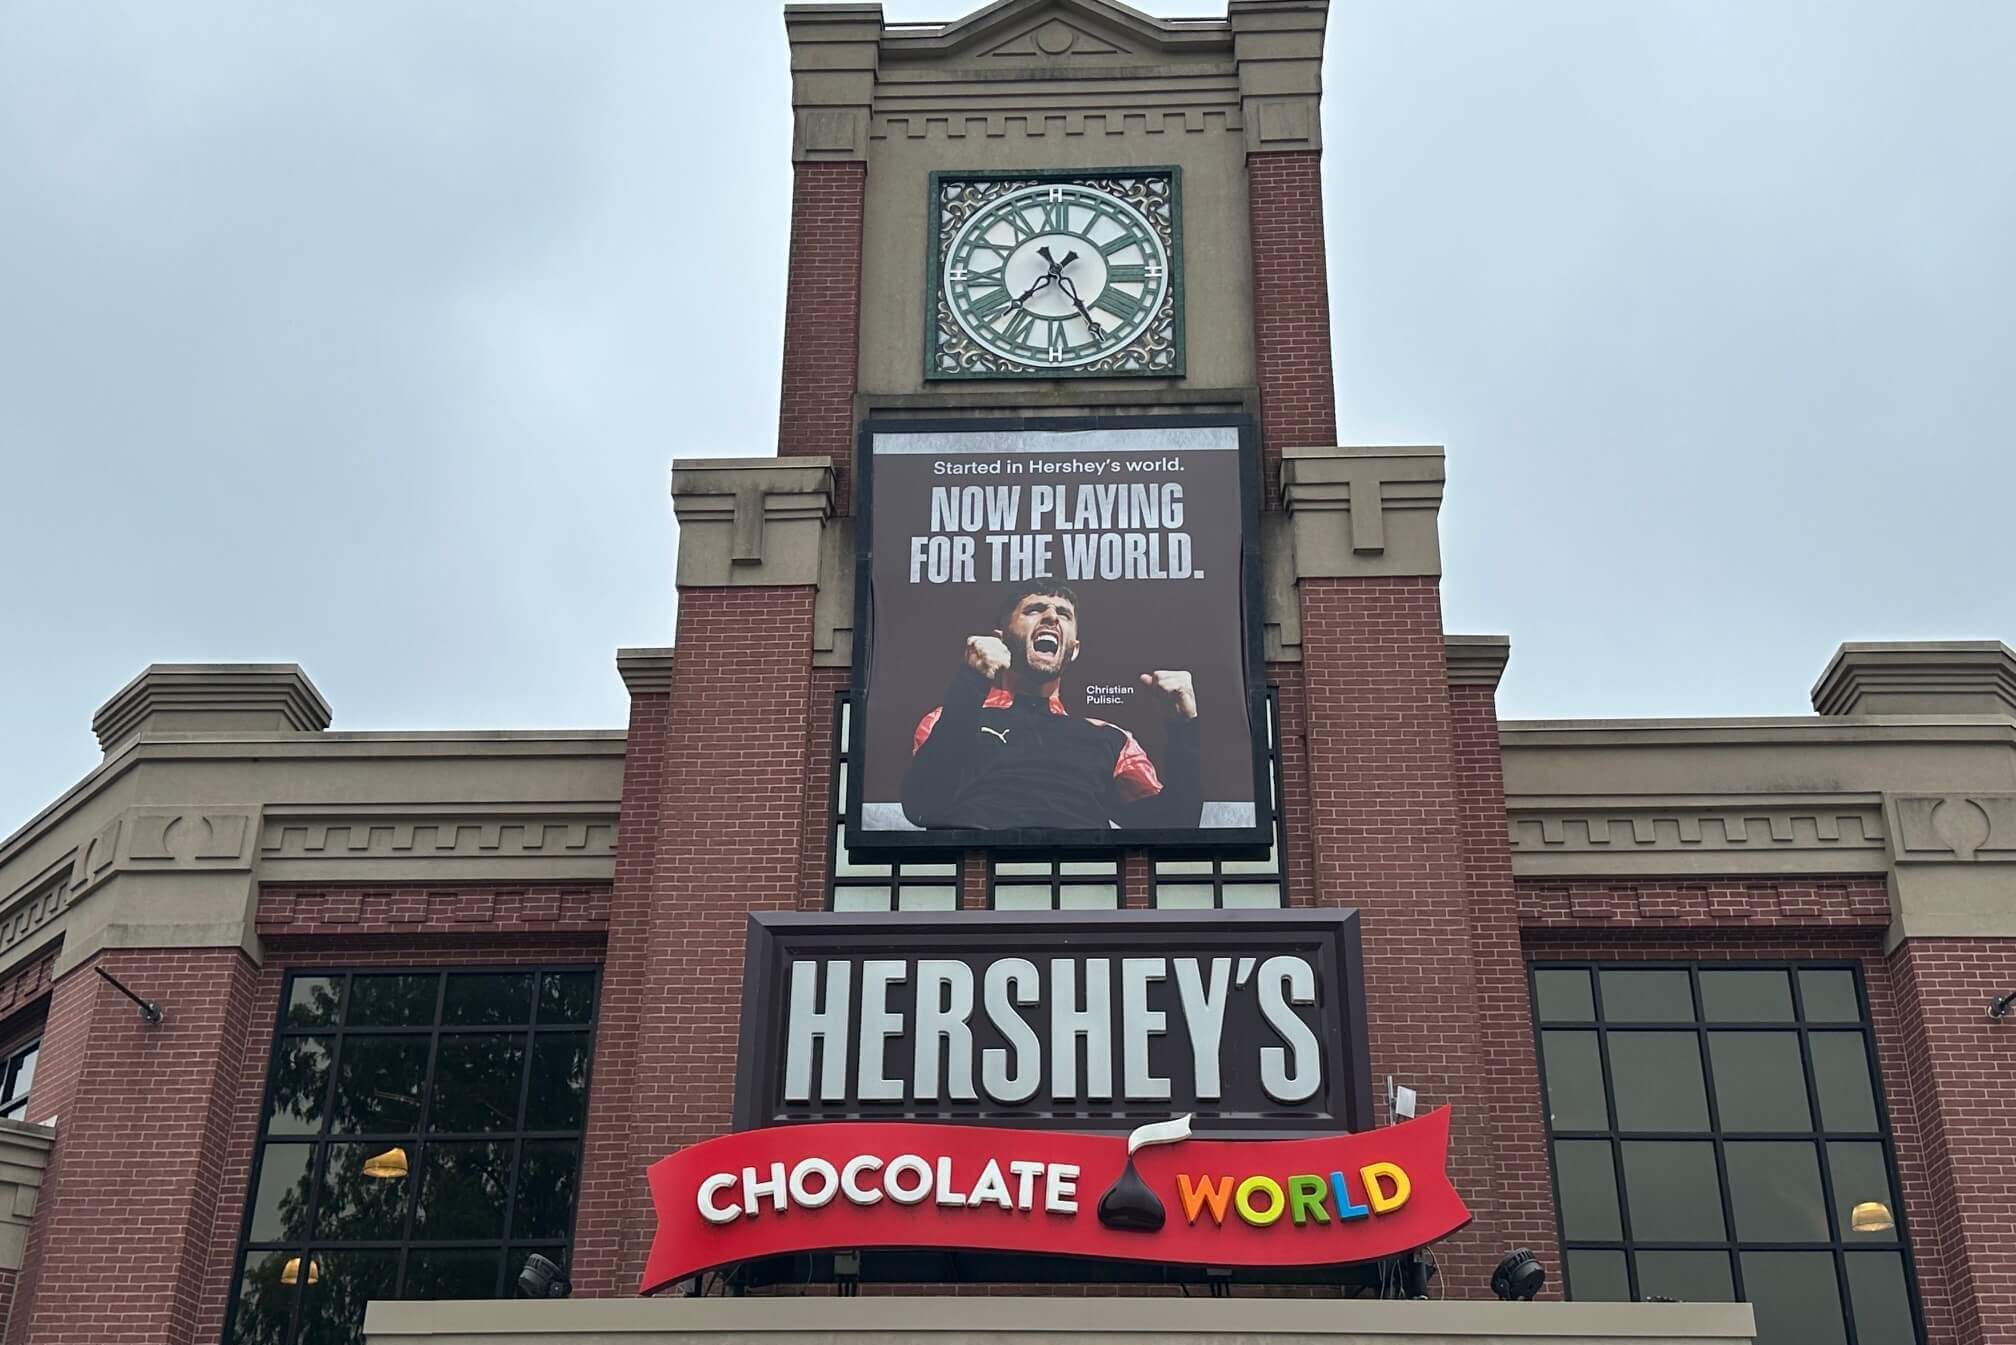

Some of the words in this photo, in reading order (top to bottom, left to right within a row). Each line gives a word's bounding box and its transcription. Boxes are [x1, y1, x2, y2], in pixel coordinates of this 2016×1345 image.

[933, 460, 1001, 475] Started
[1006, 460, 1023, 473] in
[1029, 458, 1121, 476] Hershey's
[1125, 457, 1185, 472] world.
[930, 485, 1021, 532] NOW
[1030, 482, 1184, 530] PLAYING
[909, 536, 976, 583] FOR
[985, 534, 1053, 582] THE
[1062, 532, 1205, 580] WORLD.
[1086, 685, 1134, 694] Christian
[1086, 695, 1124, 705] Pulisic.
[784, 955, 1322, 1103] HERSHEY'S
[697, 1153, 1081, 1225] CHOCOLATE
[1176, 1161, 1412, 1227] WORLD
